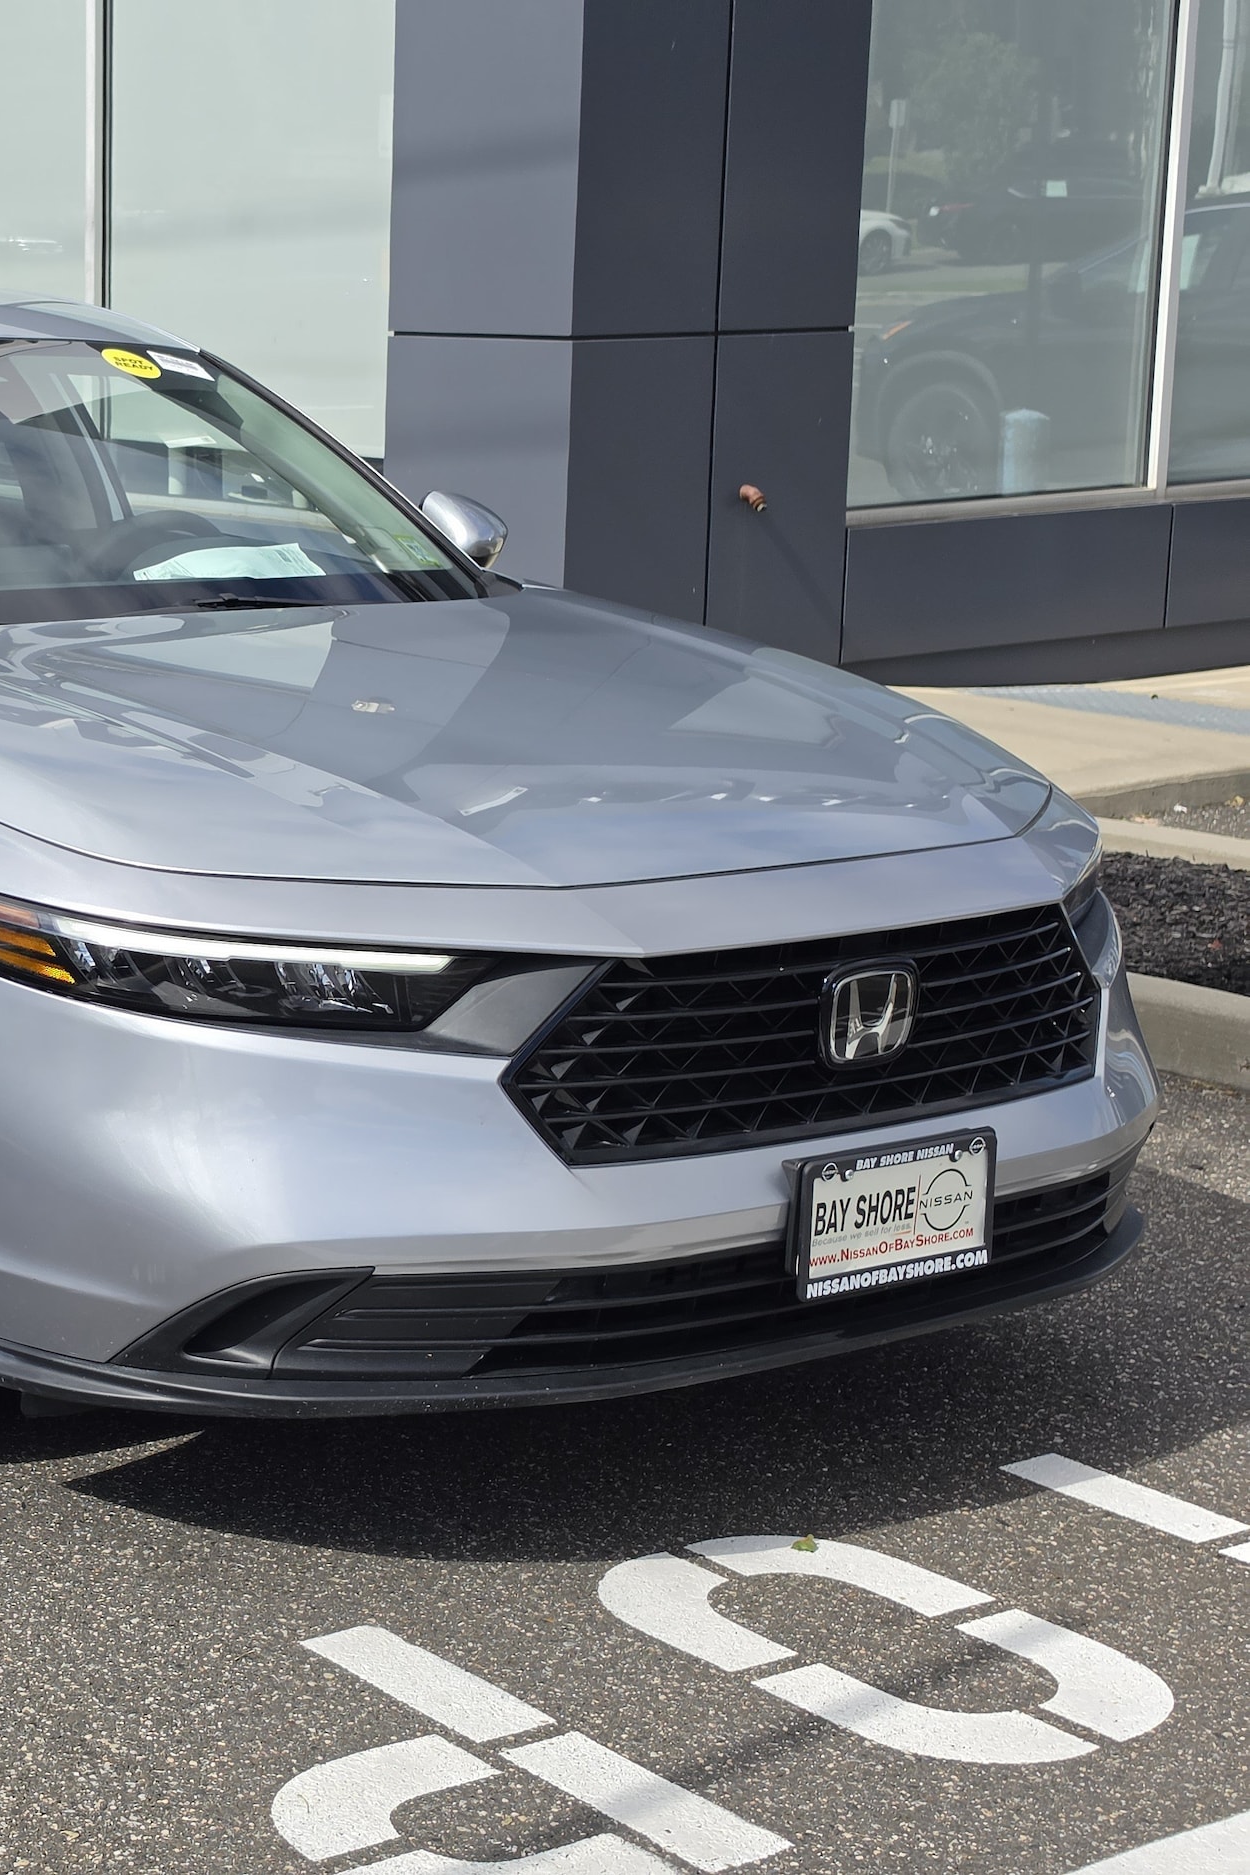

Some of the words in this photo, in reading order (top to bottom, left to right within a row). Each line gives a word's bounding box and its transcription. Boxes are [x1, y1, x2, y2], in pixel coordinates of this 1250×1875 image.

[113, 356, 144, 366] SPOT
[115, 361, 155, 371] READY
[855, 1157, 877, 1171] BAY
[879, 1150, 915, 1167] SHORE
[916, 1143, 955, 1160] NISSAN
[814, 1197, 851, 1236] BAY
[854, 1186, 916, 1229] SHORE
[919, 1190, 973, 1210] NISSAN
[812, 1234, 848, 1247] Because
[850, 1231, 862, 1240] we
[880, 1225, 892, 1235] for
[806, 1249, 989, 1300] NISSANOFBAYSHORE.COM
